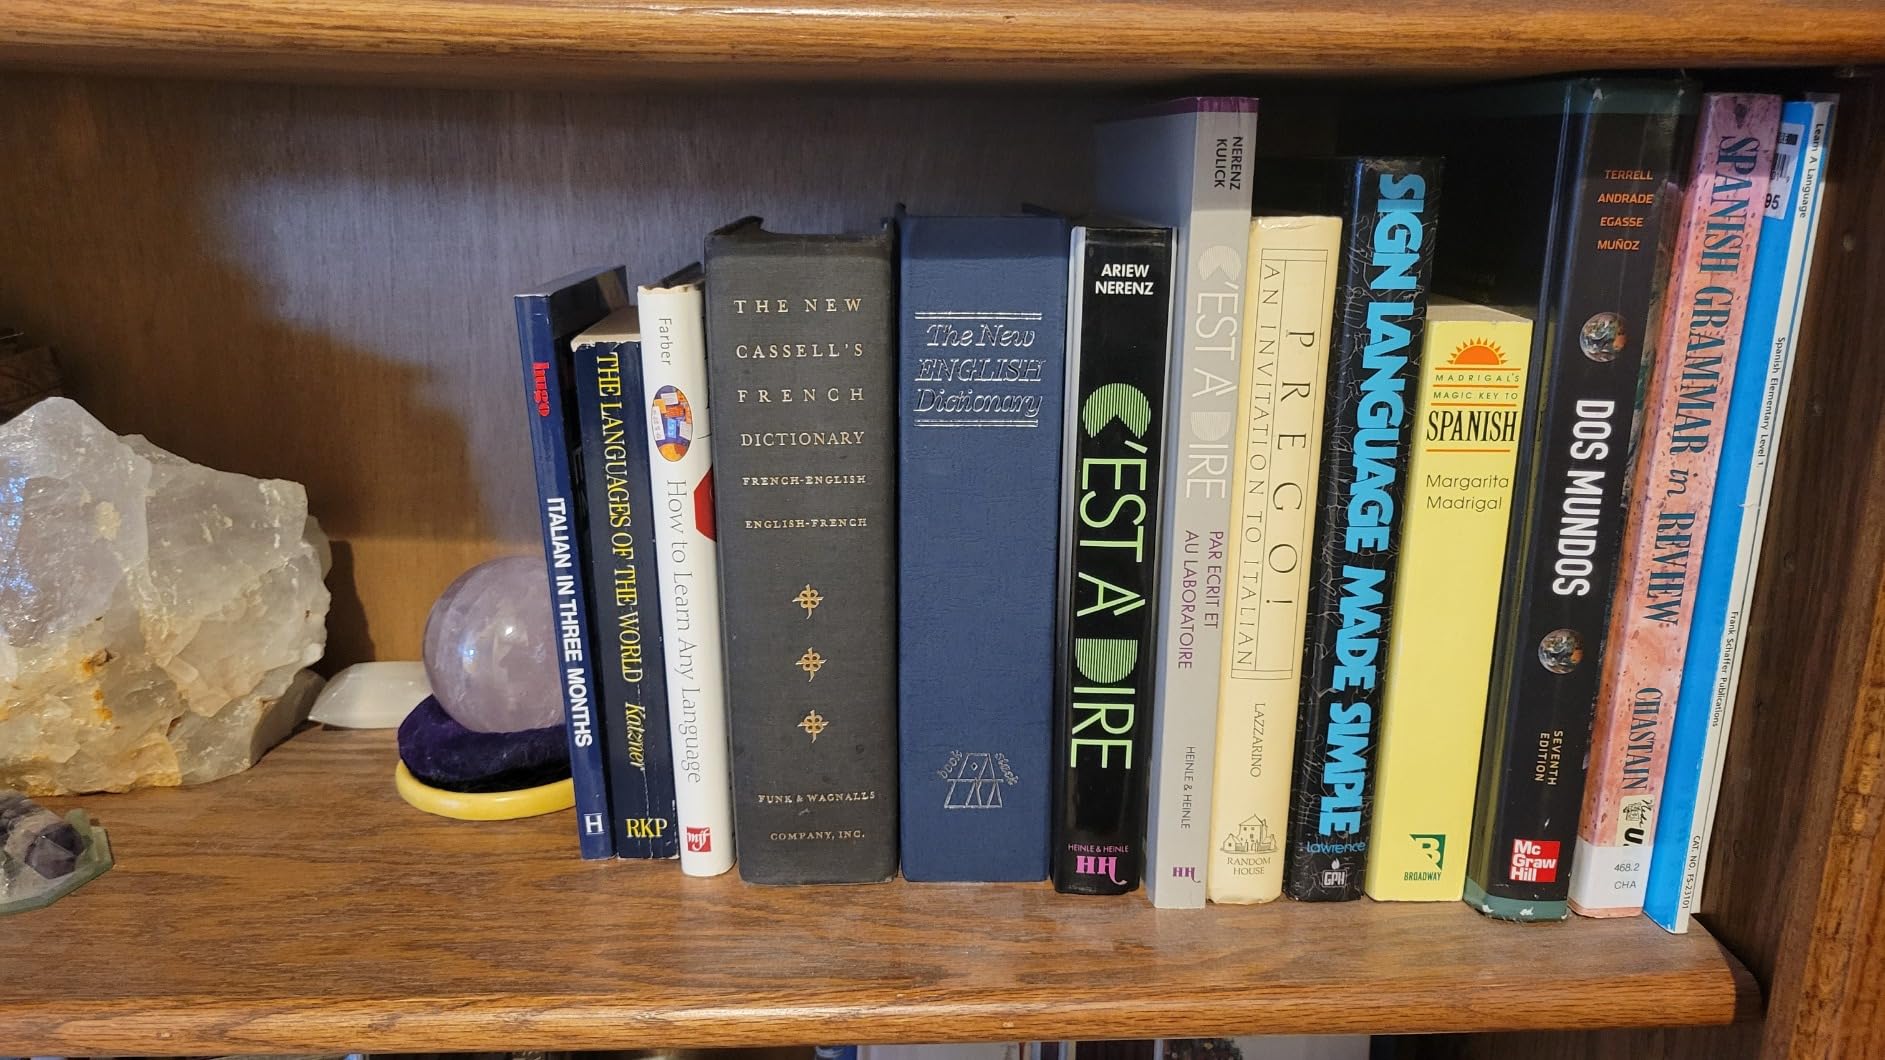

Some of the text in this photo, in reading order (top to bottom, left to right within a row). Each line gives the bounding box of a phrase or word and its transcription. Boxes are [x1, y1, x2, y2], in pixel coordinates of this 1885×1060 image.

[1214, 138, 1228, 188] KULICK
[1229, 136, 1243, 191] NERENZ
[1604, 170, 1653, 181] TERRELL
[1597, 193, 1654, 205] ANDRADE
[1799, 168, 1816, 218] Language
[1600, 217, 1644, 228] EGASSE
[1597, 238, 1640, 251] MUÑOZ
[1101, 263, 1149, 278] ARIEW
[1095, 280, 1154, 295] NERENZ
[734, 298, 862, 313] THE NEW
[1194, 245, 1242, 361] C'EST
[659, 317, 673, 365] Farber
[926, 324, 1035, 347] The New
[736, 343, 863, 359] CASSELL'S
[1770, 337, 1785, 374] Spanish
[914, 358, 1046, 382] ENGLISH
[1435, 372, 1520, 383] MADRIGAL'S
[1642, 135, 1760, 626] SPANISH GRAMMAR in REVIEW
[532, 361, 551, 417] hugo
[737, 388, 864, 403] FRENCH
[1433, 391, 1518, 401] MAGIC KEY TO
[913, 388, 1043, 418] Dictionary
[1760, 377, 1778, 430] Elementary
[1426, 410, 1518, 442] SPANISH
[740, 431, 864, 447] DICTIONARY
[1758, 434, 1768, 457] Level
[1186, 411, 1232, 499] DIRE
[1237, 263, 1281, 665] AN INVITATION TO ITALIAN
[742, 475, 866, 486] FRENCH-ENGLISH
[1079, 382, 1151, 563] C'EST
[1426, 474, 1509, 491] Margarita
[1319, 173, 1426, 836] SIGN LANGUAGE MADE SIMPLE
[1427, 496, 1502, 512] Madrigal
[1552, 400, 1615, 597] DOS MUNDOS
[596, 352, 643, 683] THE LANGUAGES OF THE WORLD
[745, 518, 867, 529] ENGLISH-FRENCH
[1203, 531, 1224, 629] PAR ECRIT ET
[1178, 530, 1199, 669] AU LABORATOIRE
[547, 497, 593, 748] ITALIAN IN THREE MONTHS
[666, 479, 701, 784] How to Learn Any Language
[1712, 611, 1739, 727] Frank Schaffer Publications
[1070, 638, 1138, 770] DIRE
[623, 702, 646, 769] Katzner
[1250, 703, 1266, 778] LAZZARINO
[1622, 687, 1663, 791] CHASTAIN
[1184, 746, 1196, 782] HEINLE
[1535, 733, 1550, 782] EDITION
[1548, 730, 1563, 785] SEVENTH
[758, 794, 792, 803] FUNK
[807, 791, 876, 803] WAGNALLS
[1180, 794, 1192, 829] HEINLE
[625, 818, 668, 839] RKP
[770, 830, 865, 841] COMPANY, INC.
[1068, 844, 1095, 853] HEINLE
[1103, 845, 1129, 853] HEINLE
[1513, 839, 1541, 856] Mc
[1227, 857, 1271, 866] RANDOM
[1233, 867, 1265, 875] HOUSE
[1512, 853, 1557, 869] Graw
[1614, 863, 1640, 873] 468.2
[1682, 835, 1701, 909] CAT. NO. FS-23101
[1323, 871, 1346, 886] GPH
[1404, 871, 1441, 881] BROADWAY
[1510, 866, 1537, 881] Hill
[1614, 880, 1637, 889] CHA
